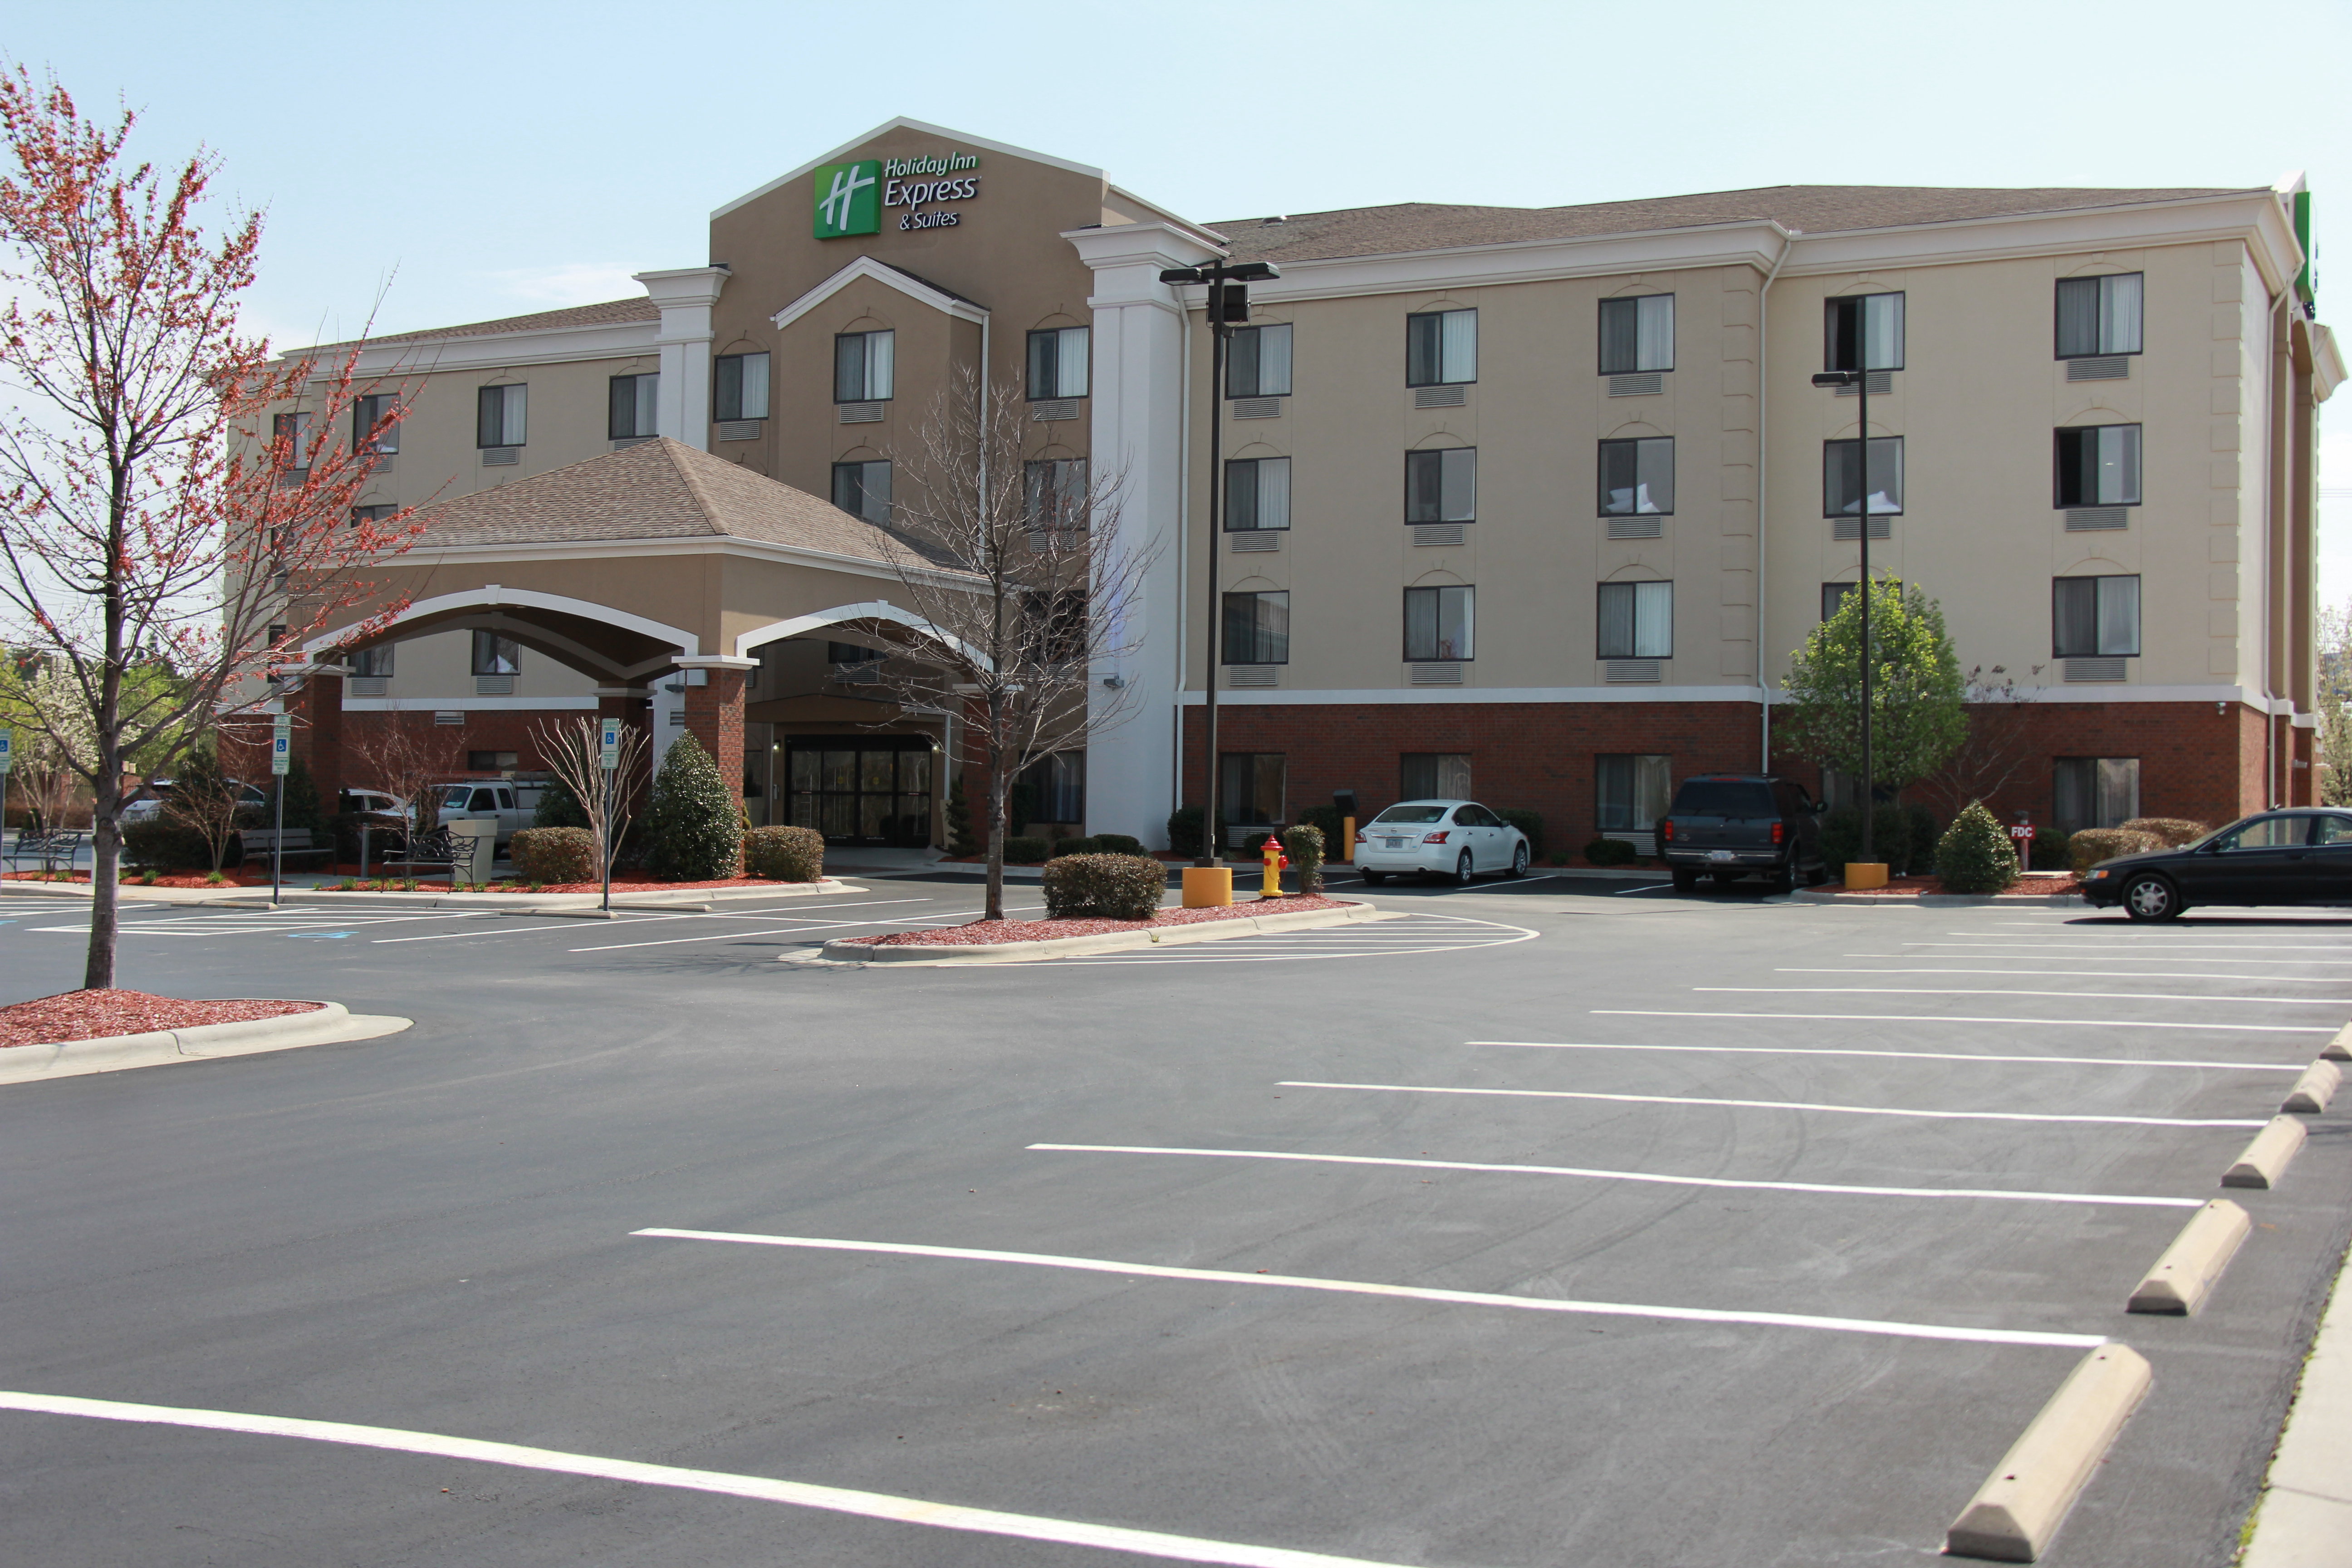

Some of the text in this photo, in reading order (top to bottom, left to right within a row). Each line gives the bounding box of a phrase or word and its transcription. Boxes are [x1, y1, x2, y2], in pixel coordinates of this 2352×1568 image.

[884, 178, 976, 211] Express
[900, 211, 958, 230] & Suites
[2011, 826, 2033, 837] FDC
